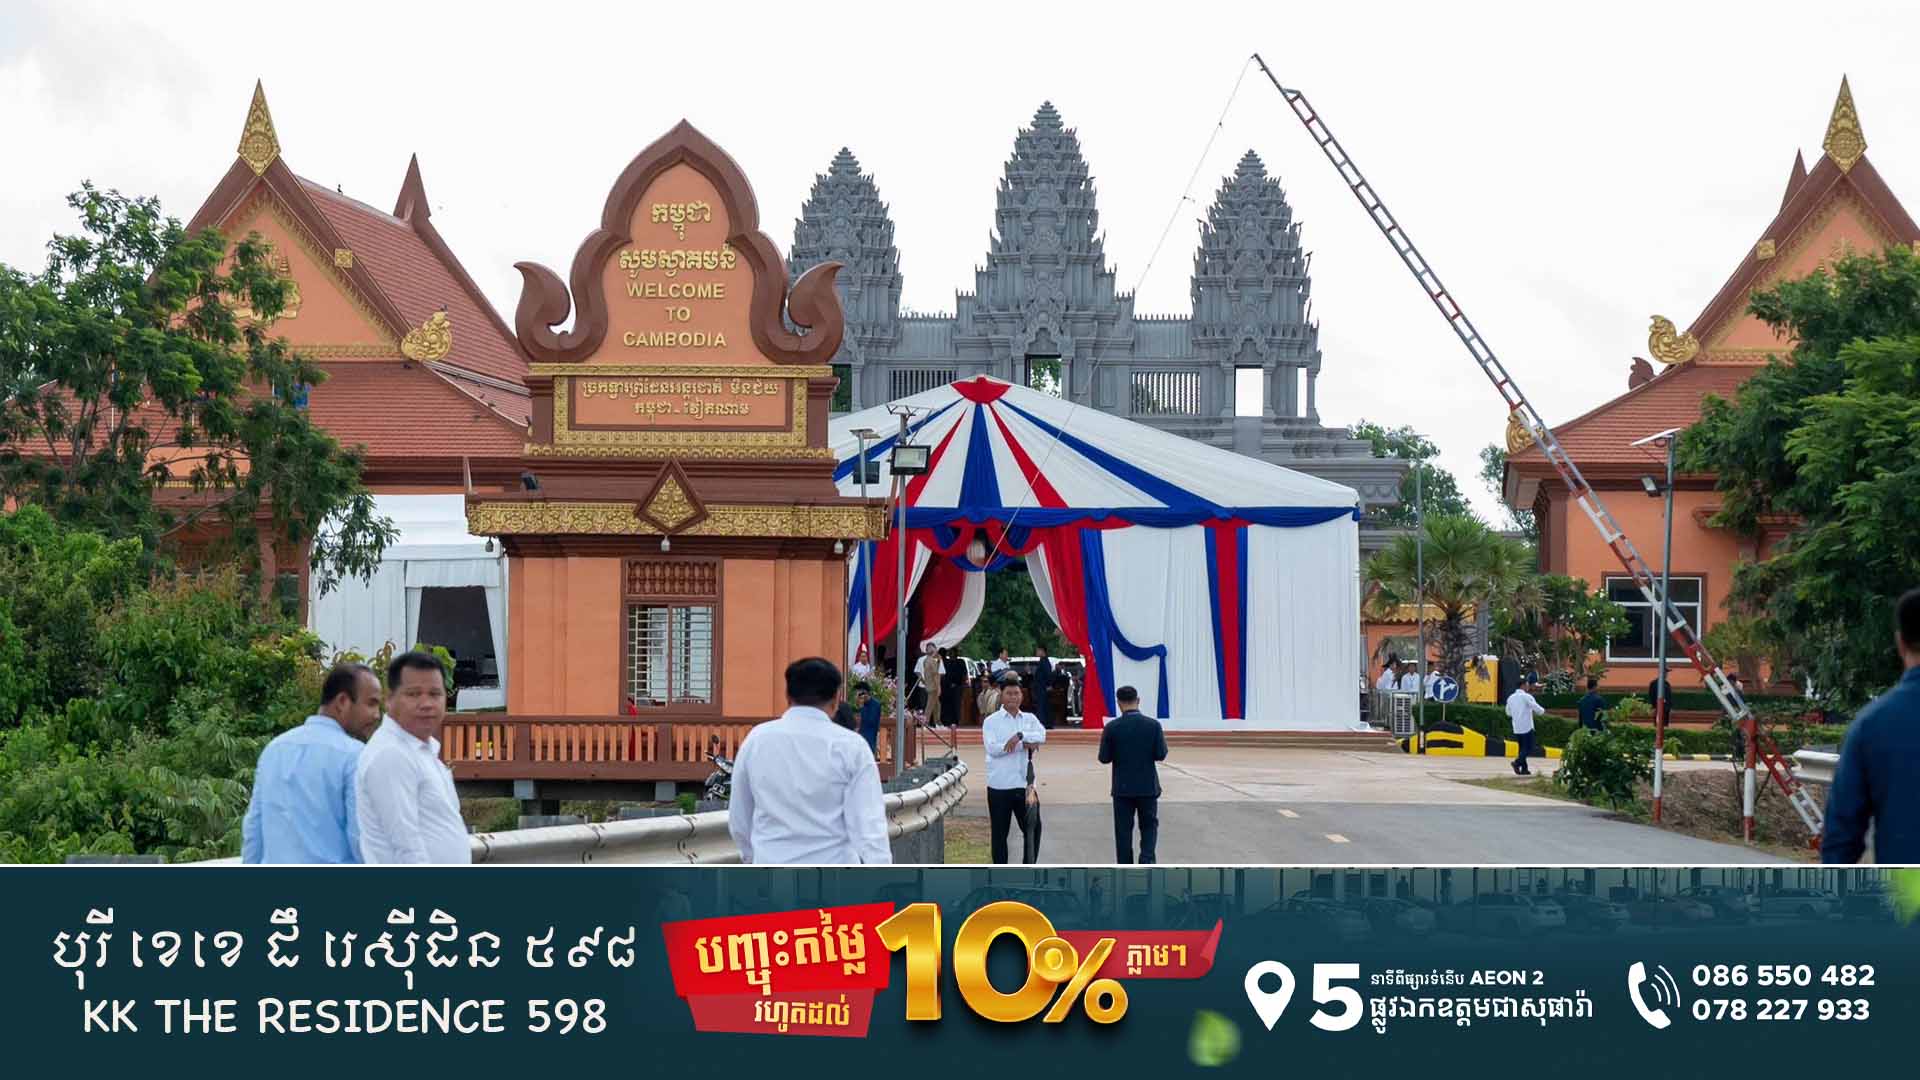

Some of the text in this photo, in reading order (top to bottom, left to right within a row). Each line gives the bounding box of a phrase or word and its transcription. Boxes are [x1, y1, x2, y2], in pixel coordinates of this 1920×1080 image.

[652, 201, 711, 240] កម្ពុជា
[619, 243, 736, 278] សូមស្វាគមន៍
[627, 282, 725, 298] WELCOME
[665, 306, 690, 321] TO
[623, 331, 727, 347] CAMBODIA
